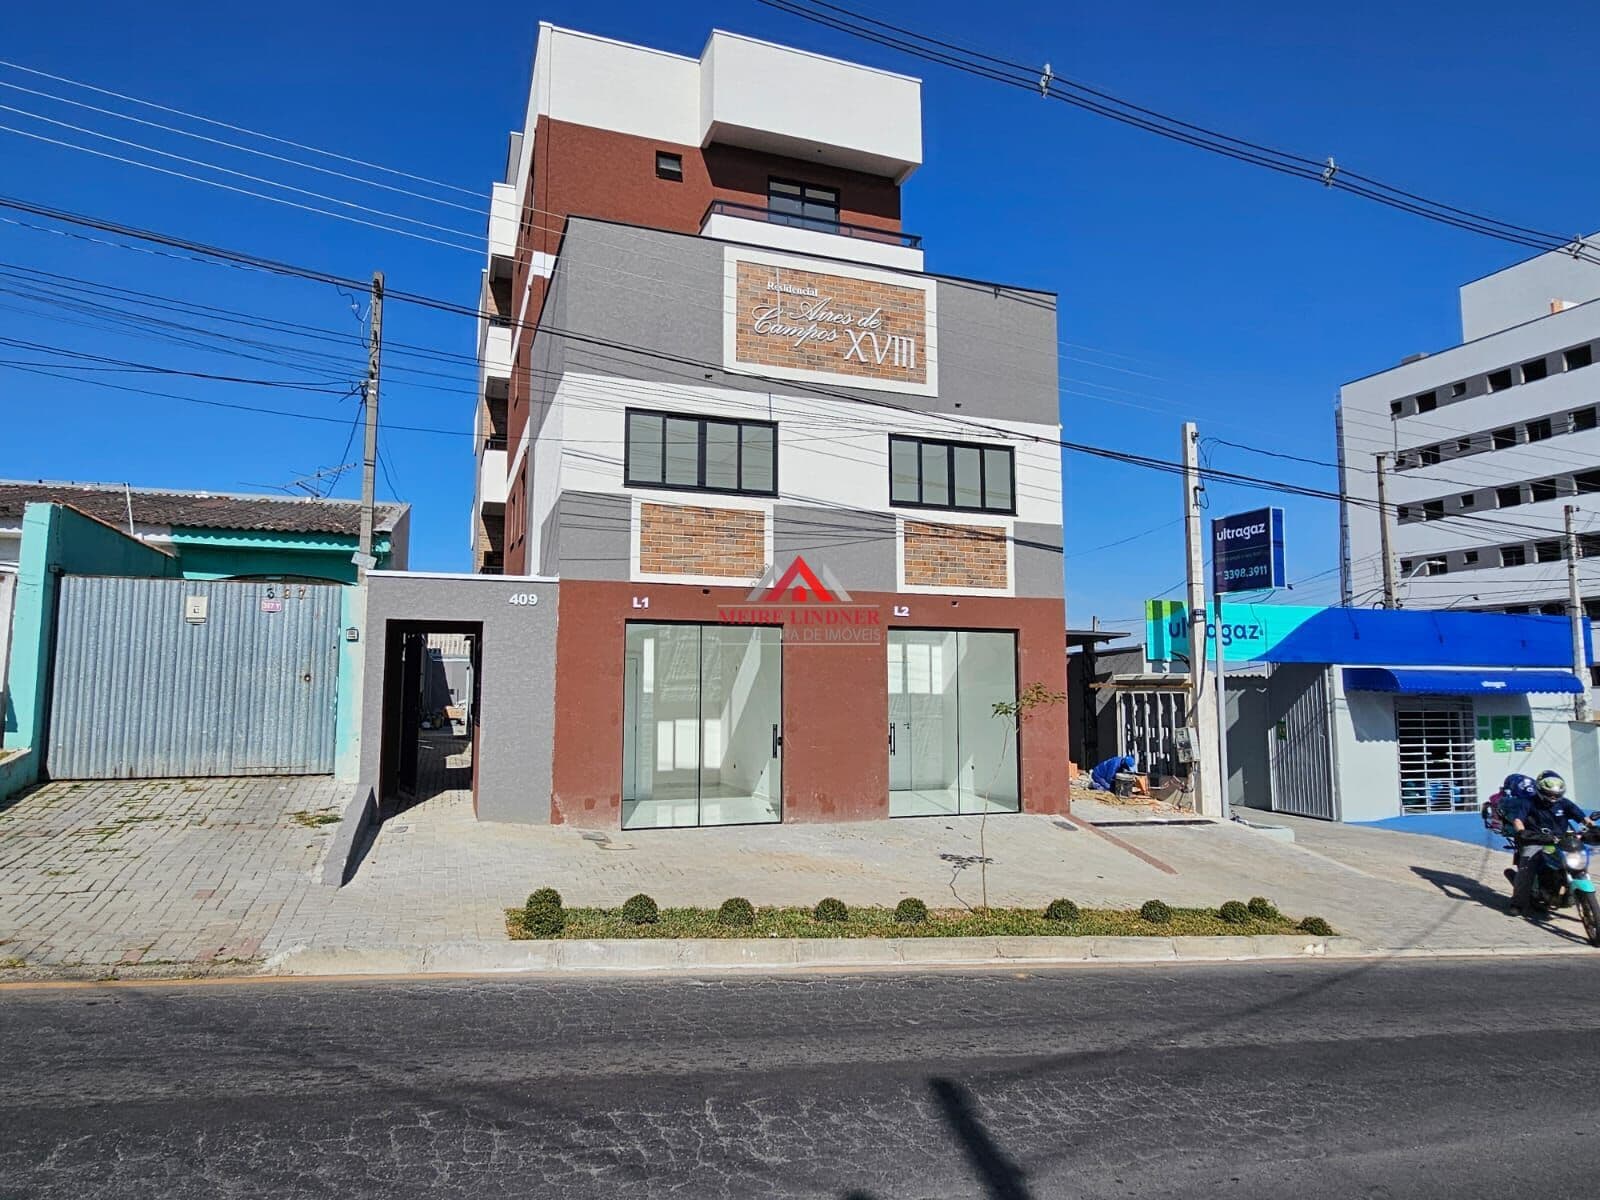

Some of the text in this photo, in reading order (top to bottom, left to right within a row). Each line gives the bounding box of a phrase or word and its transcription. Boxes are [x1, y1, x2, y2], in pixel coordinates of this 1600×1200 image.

[767, 281, 818, 297] Residencial
[790, 296, 882, 329] Aires de
[752, 305, 915, 369] Campos XVIII
[1216, 522, 1266, 541] ultragaz
[1223, 565, 1268, 581] 3398.3911
[508, 593, 538, 605] 409
[632, 597, 649, 609] L1
[893, 606, 910, 617] L2
[1169, 617, 1260, 646] ulagaz
